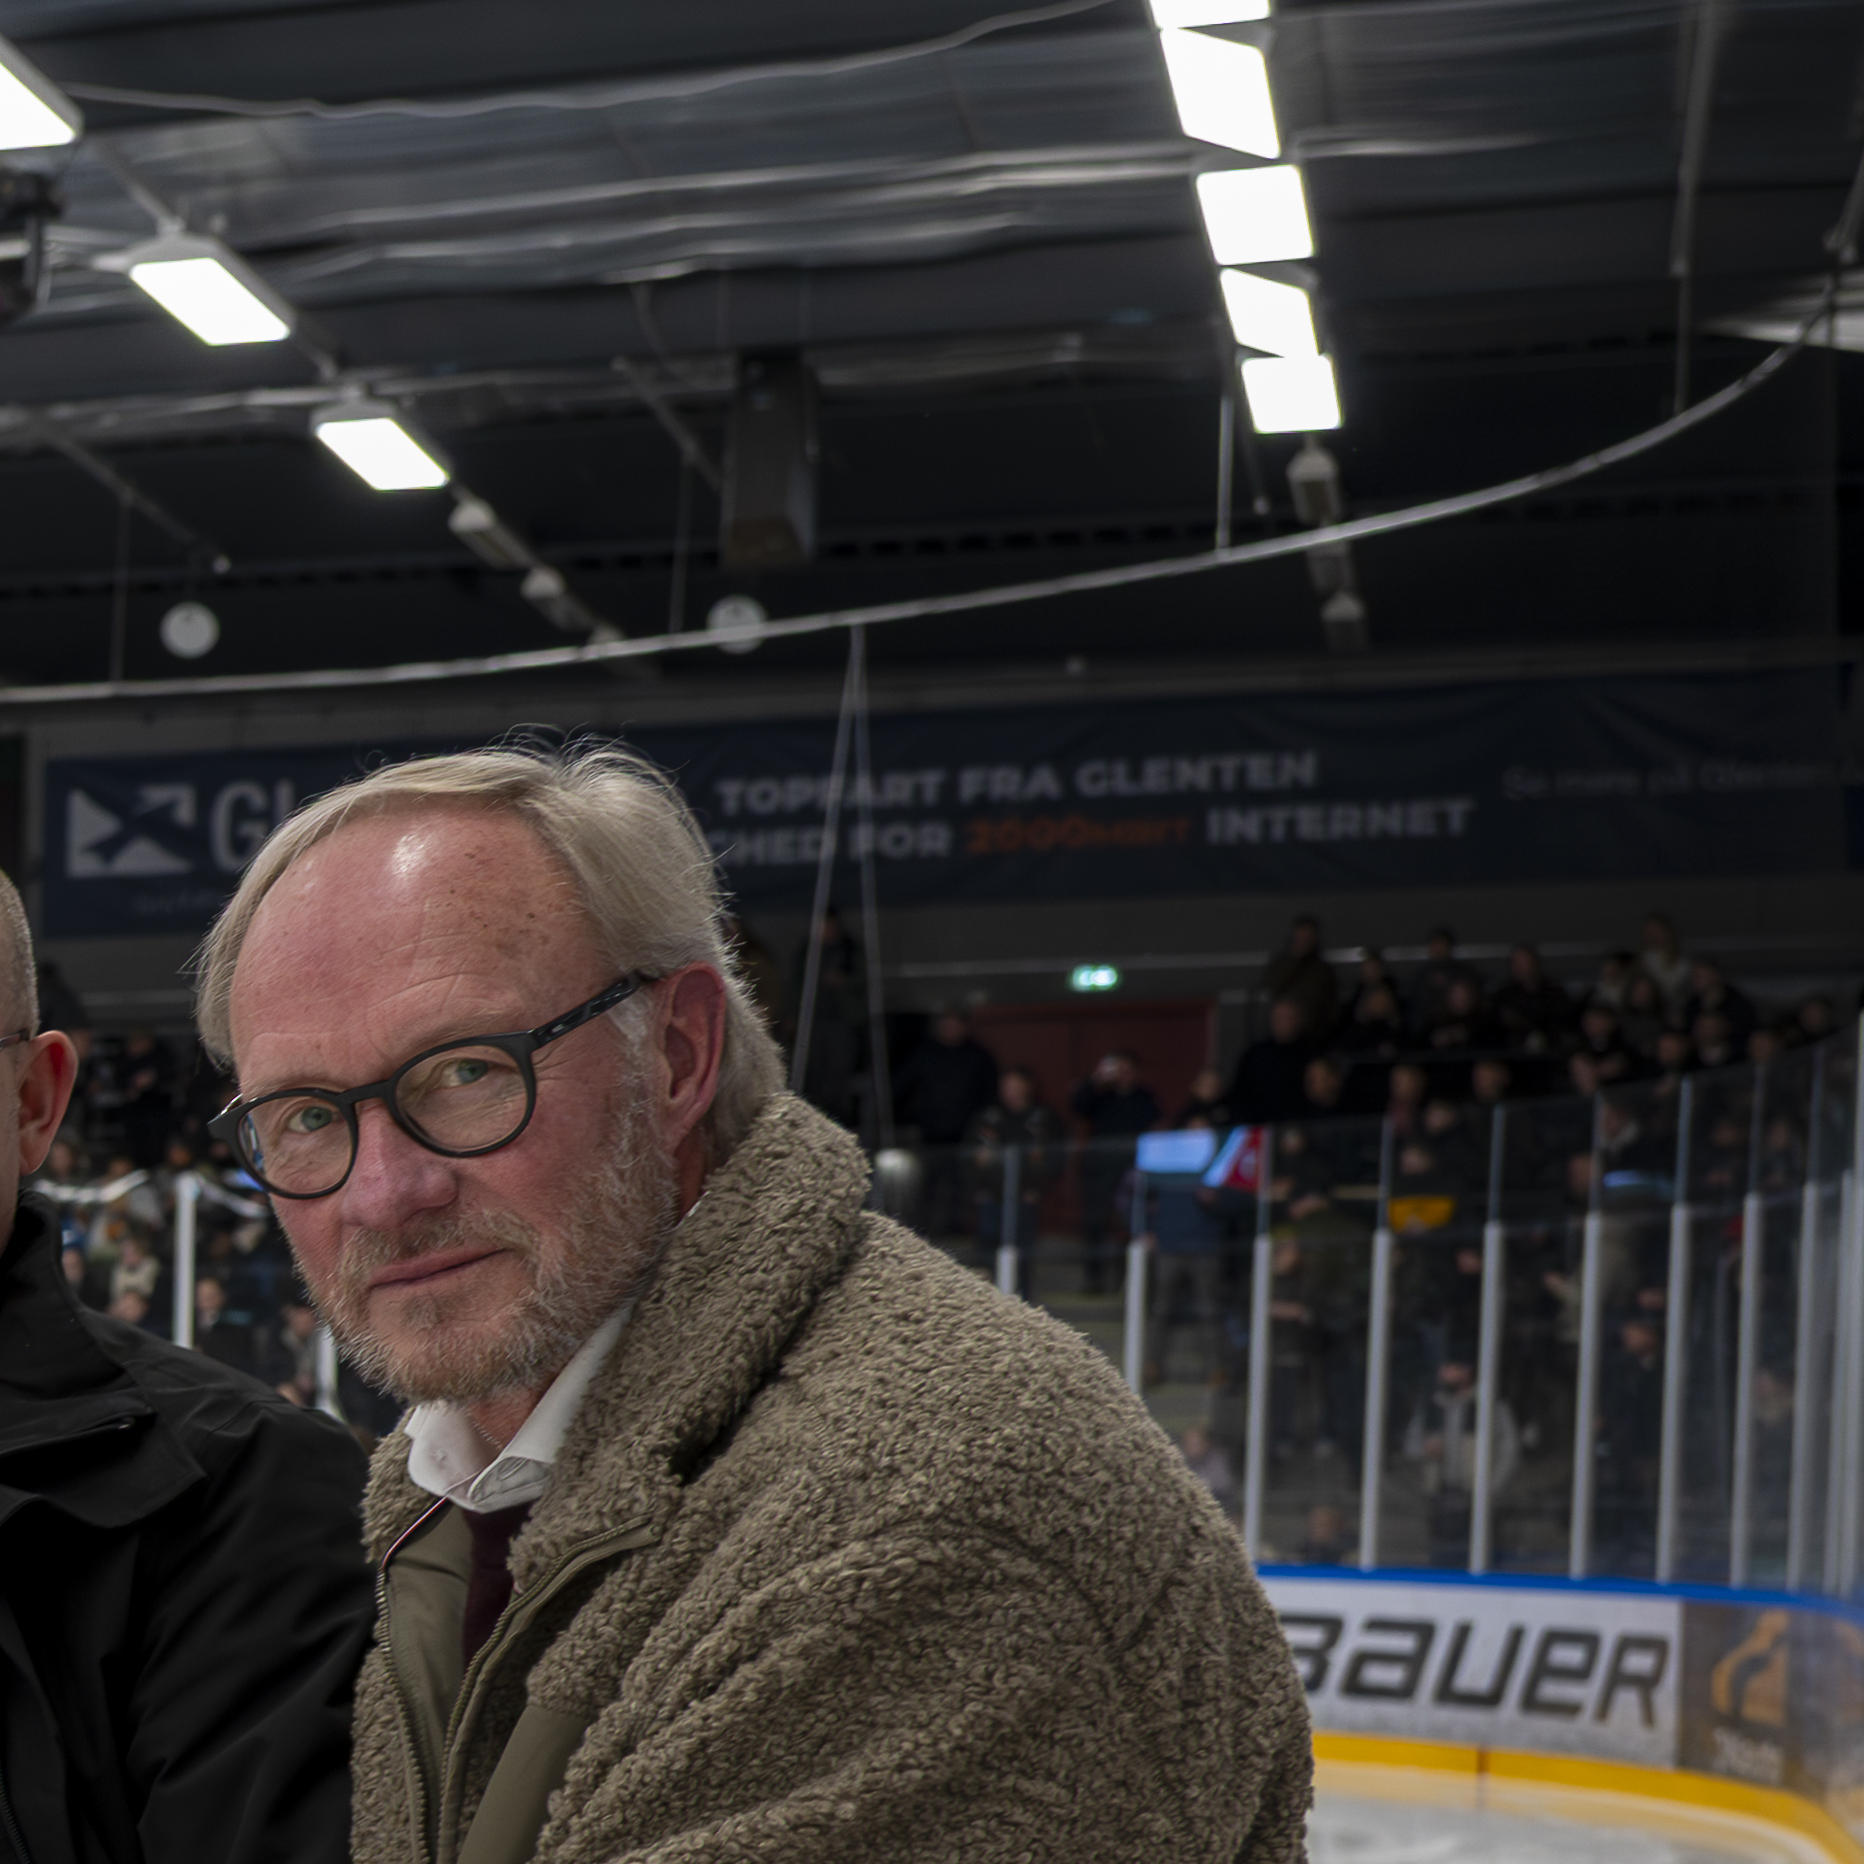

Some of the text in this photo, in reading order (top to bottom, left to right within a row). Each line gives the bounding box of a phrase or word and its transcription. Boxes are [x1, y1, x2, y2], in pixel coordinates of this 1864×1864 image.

[958, 763, 1062, 805] FRA
[1074, 749, 1319, 797] GLENTEN
[1206, 795, 1475, 846] INTERNET
